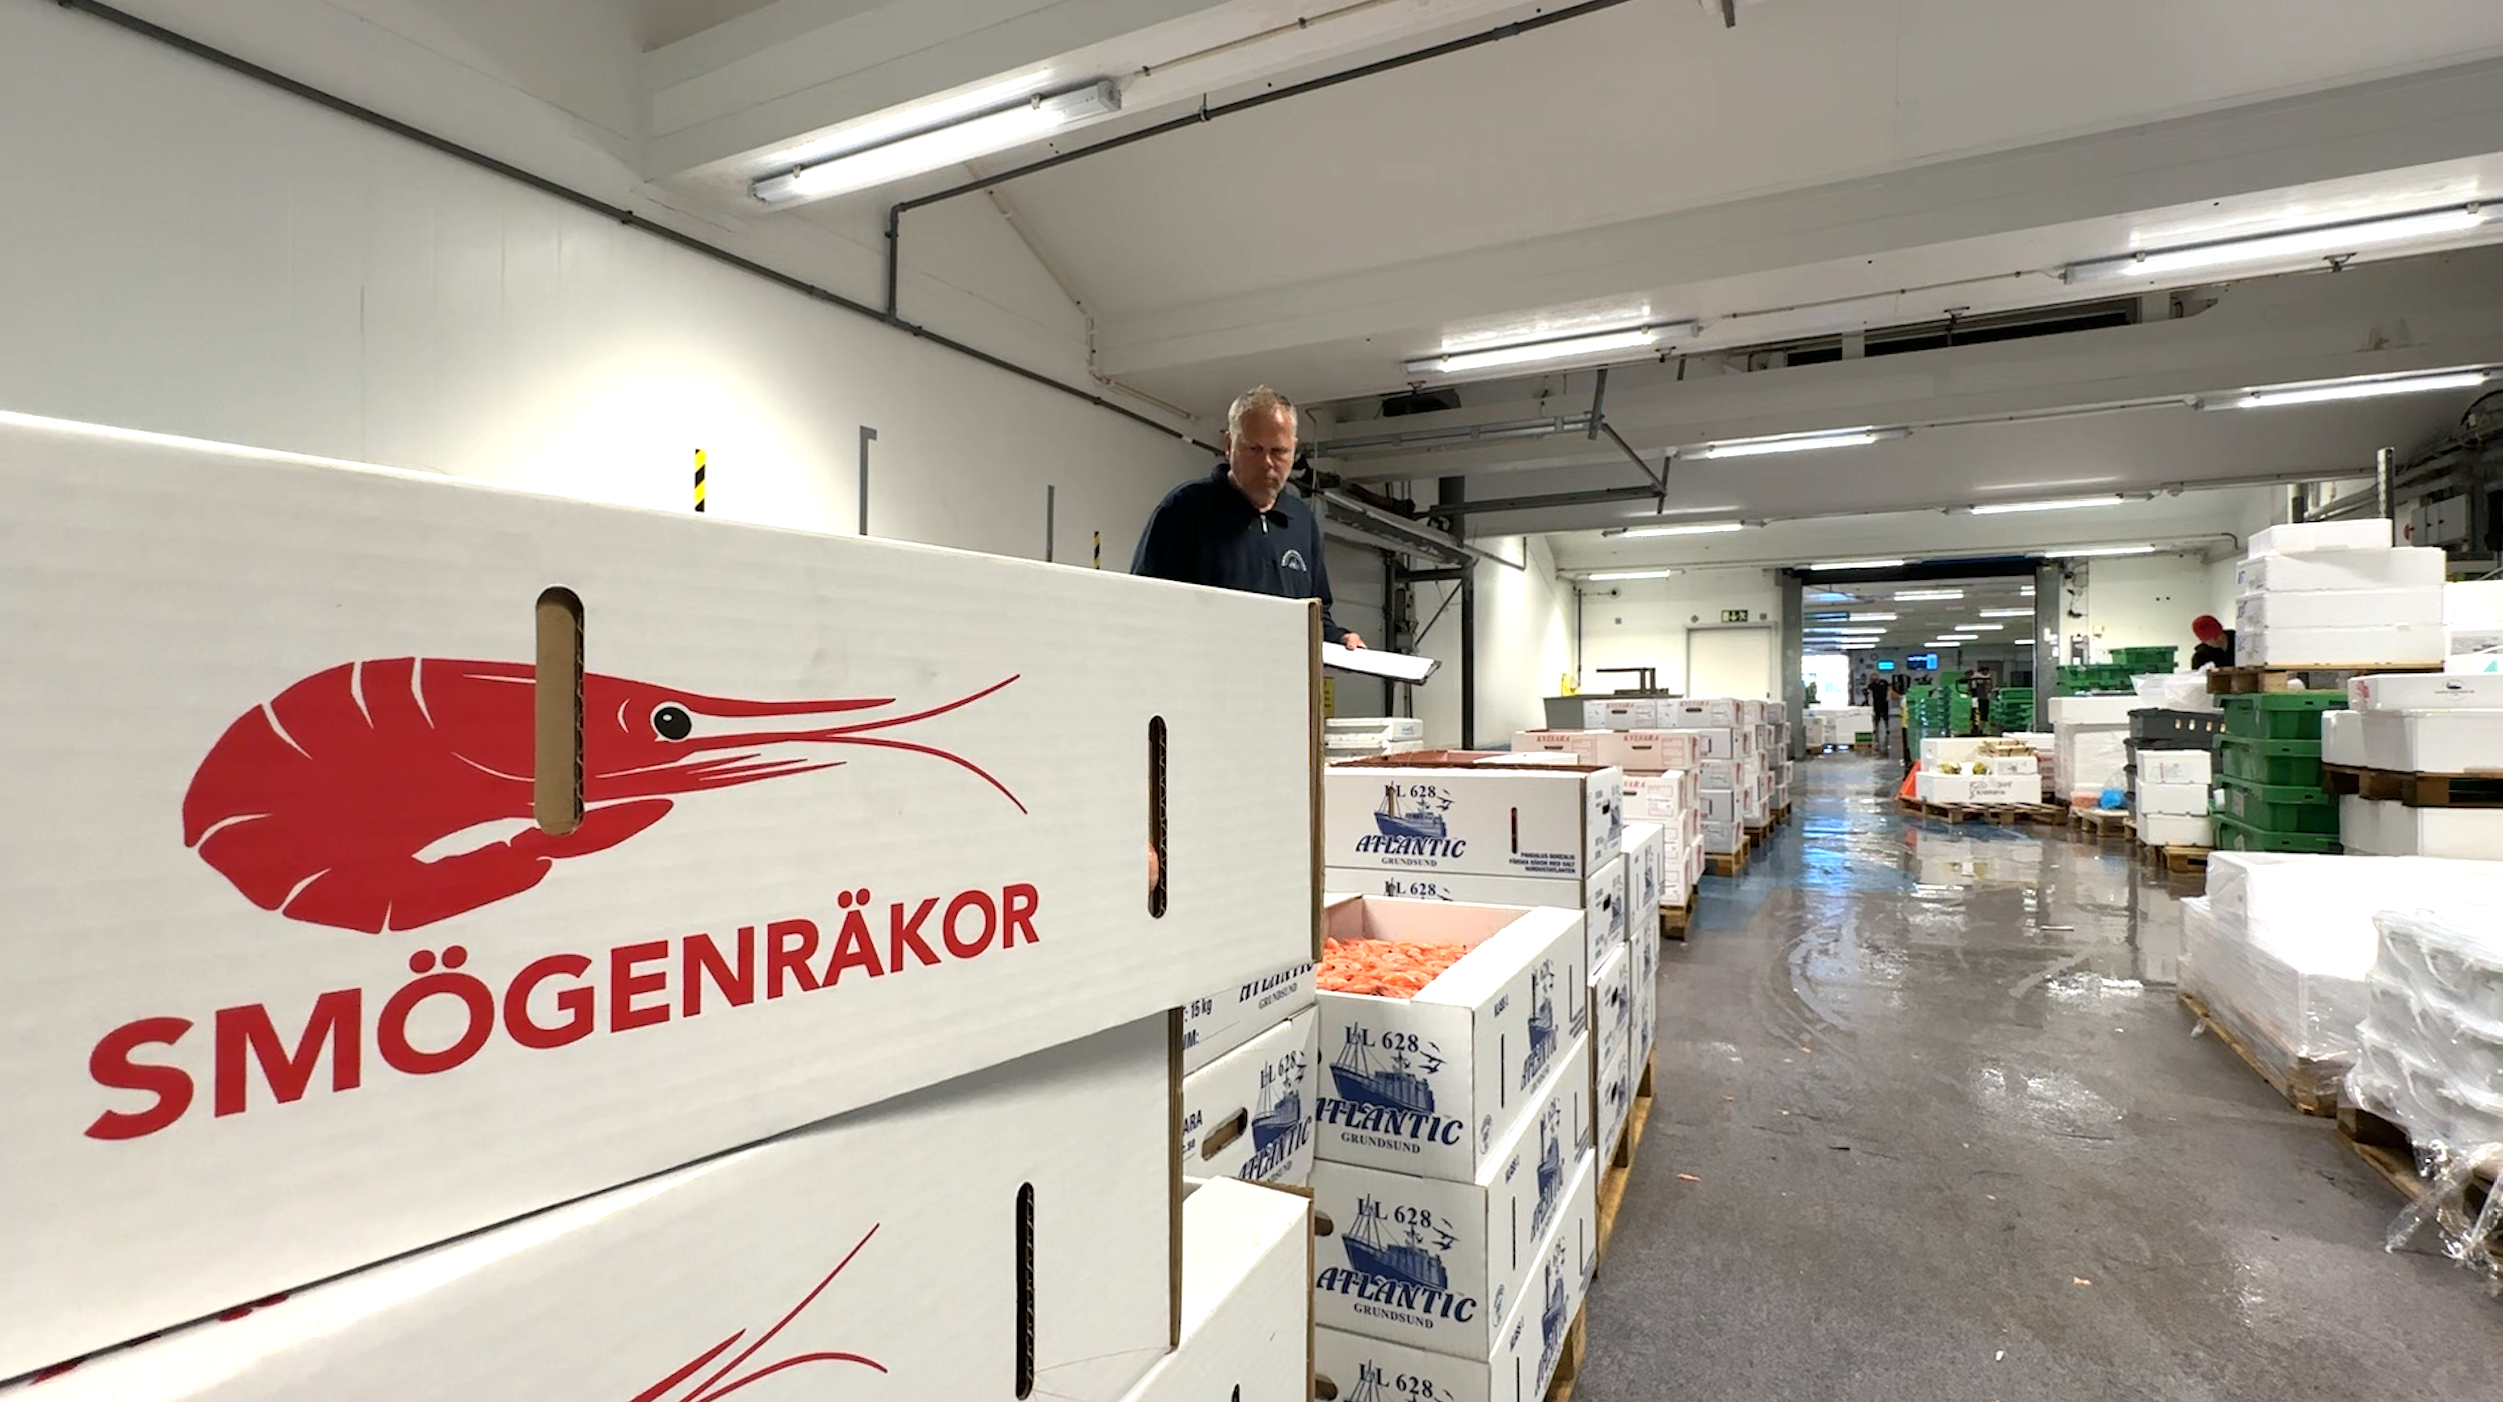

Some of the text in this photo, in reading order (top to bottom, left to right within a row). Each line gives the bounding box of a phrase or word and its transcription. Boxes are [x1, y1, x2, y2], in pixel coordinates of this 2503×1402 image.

[1410, 784, 1437, 798] 628
[1355, 834, 1467, 859] ATLANTIC
[1381, 857, 1438, 867] GRUNDSUND
[1410, 882, 1437, 896] 628
[1191, 1000, 1200, 1019] 15
[1202, 998, 1213, 1016] kg
[1258, 982, 1299, 1010] GRUNDSUND
[84, 883, 1040, 1141] SMÖGENRÄKOR
[1382, 1031, 1419, 1054] 628
[1277, 1050, 1297, 1077] 628
[1239, 1115, 1312, 1180] ATLANTIC
[1341, 1131, 1421, 1155] GRUNDSUND
[1394, 1205, 1432, 1229] 628
[1316, 1266, 1477, 1323] ATLANTIC
[1353, 1301, 1434, 1329] GRUNDSUND
[1396, 1374, 1433, 1399] 628
